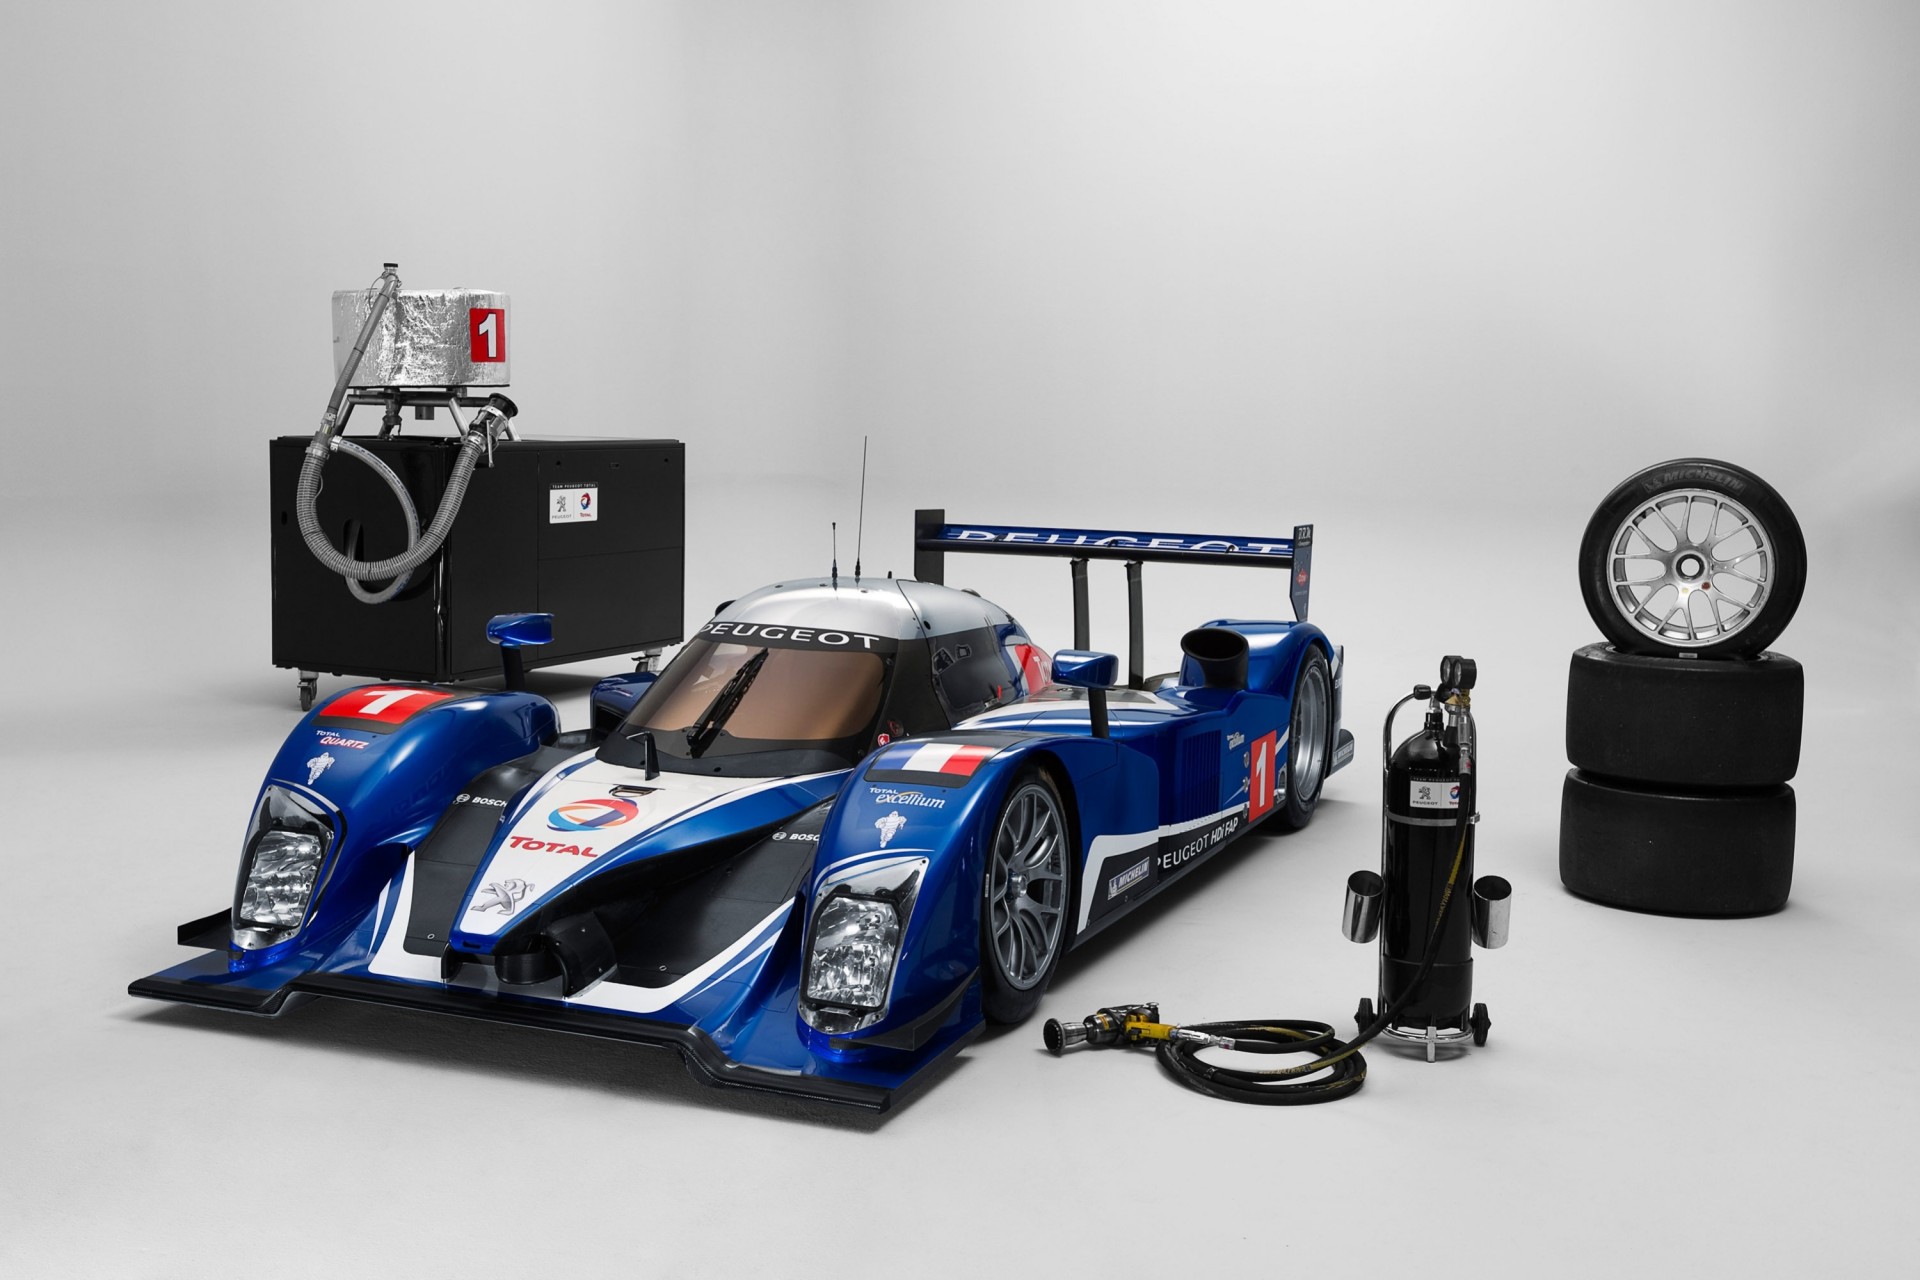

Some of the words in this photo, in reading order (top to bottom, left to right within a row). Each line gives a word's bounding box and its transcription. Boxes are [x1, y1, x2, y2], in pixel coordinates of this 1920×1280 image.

[478, 313, 497, 358] 1
[358, 689, 432, 715] 1
[320, 736, 369, 749] QUARTZ
[1256, 741, 1267, 808] 1
[869, 787, 899, 795] TOTAL
[875, 792, 946, 809] excellium
[1224, 817, 1239, 837] FAP
[510, 836, 599, 858] TOTAL
[1118, 860, 1149, 888] MICHELIN
